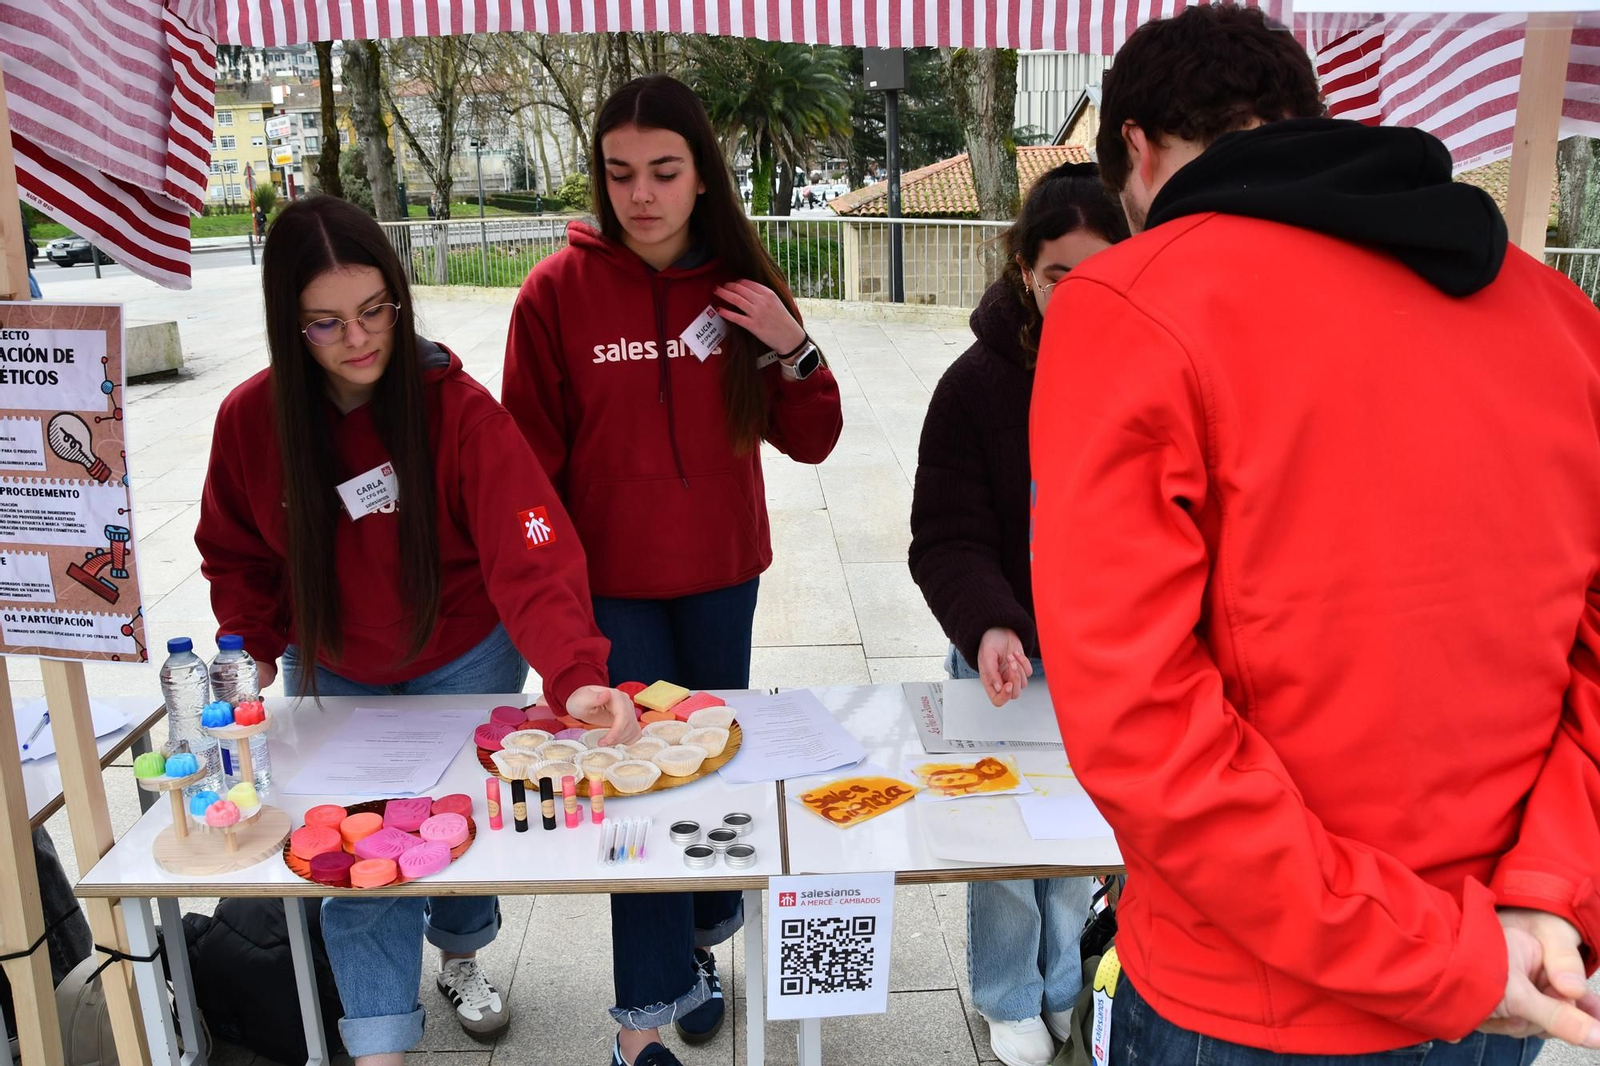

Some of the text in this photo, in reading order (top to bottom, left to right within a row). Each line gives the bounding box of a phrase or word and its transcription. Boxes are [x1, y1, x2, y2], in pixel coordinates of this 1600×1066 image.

[696, 321, 713, 340] ALICIA
[53, 348, 74, 364] DE
[0, 365, 58, 386] ÉTICOS
[0, 487, 80, 498] PROCEDEMENTO
[356, 479, 384, 496] CARLA
[4, 614, 94, 627] 04. PARTICIPACIÓN
[801, 785, 869, 808] Sales
[801, 888, 861, 899] salesianos
[807, 898, 833, 906] MERCÉ
[840, 896, 881, 905] CAMBADOS
[1096, 998, 1104, 1044] salesianos
